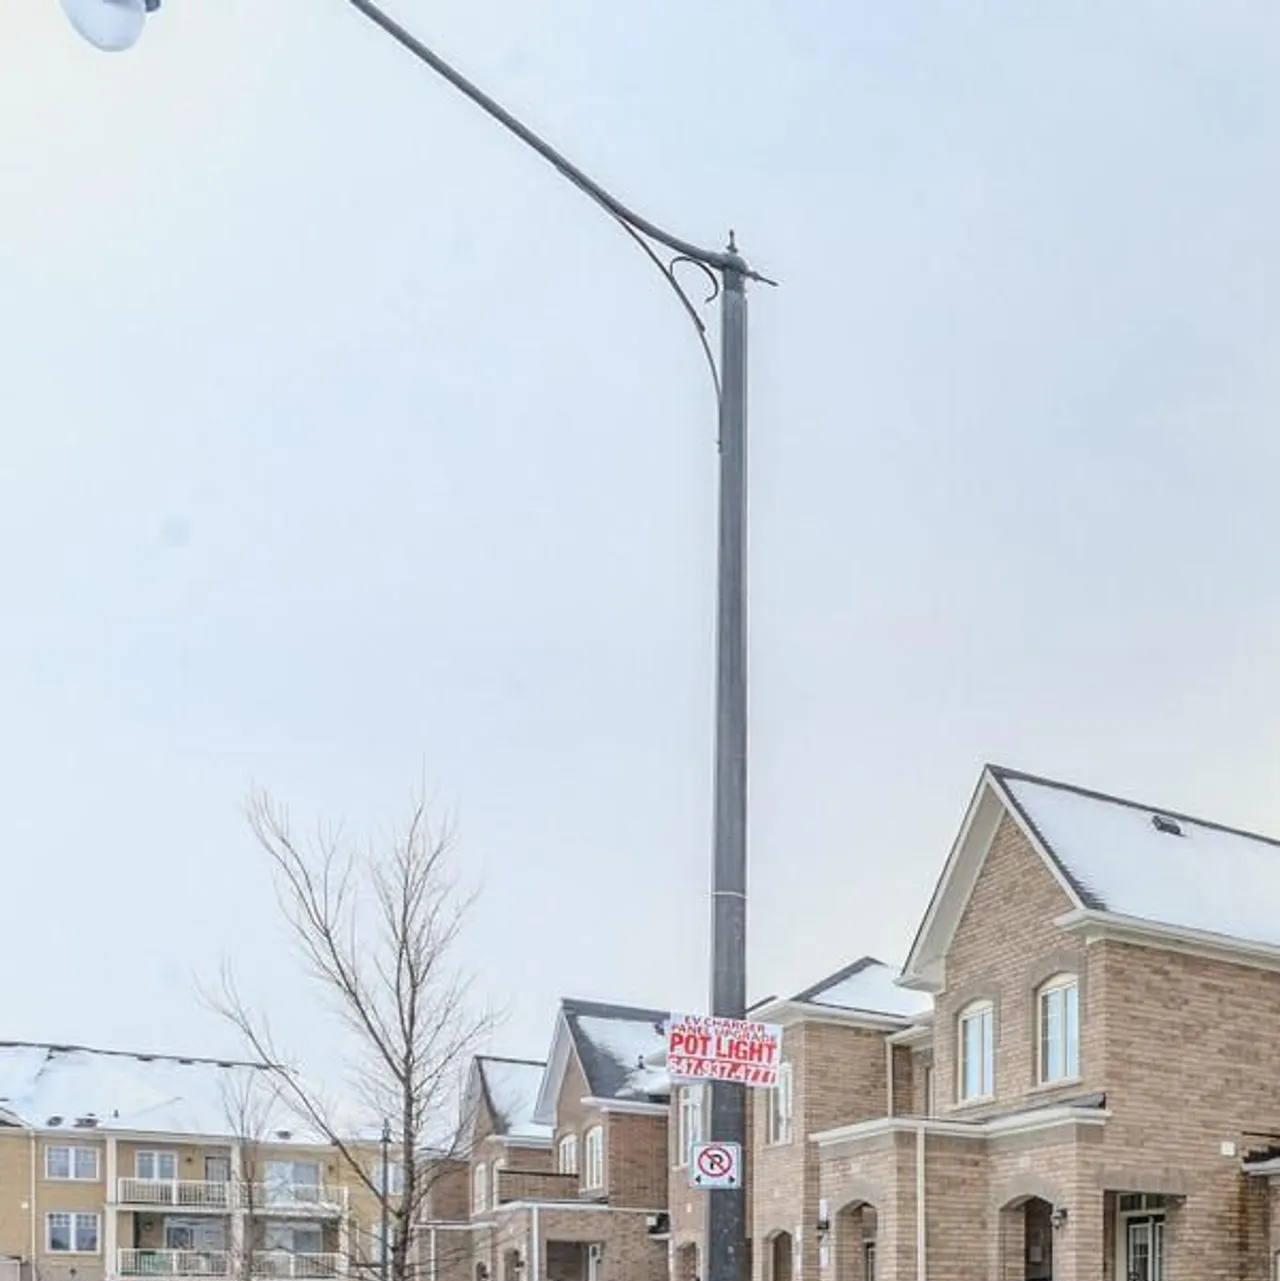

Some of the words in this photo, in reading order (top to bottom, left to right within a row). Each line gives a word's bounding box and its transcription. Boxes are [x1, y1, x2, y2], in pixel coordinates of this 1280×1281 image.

[704, 1017, 765, 1033] CHARGER
[670, 1033, 711, 1056] POT
[716, 1036, 776, 1063] LIGHT
